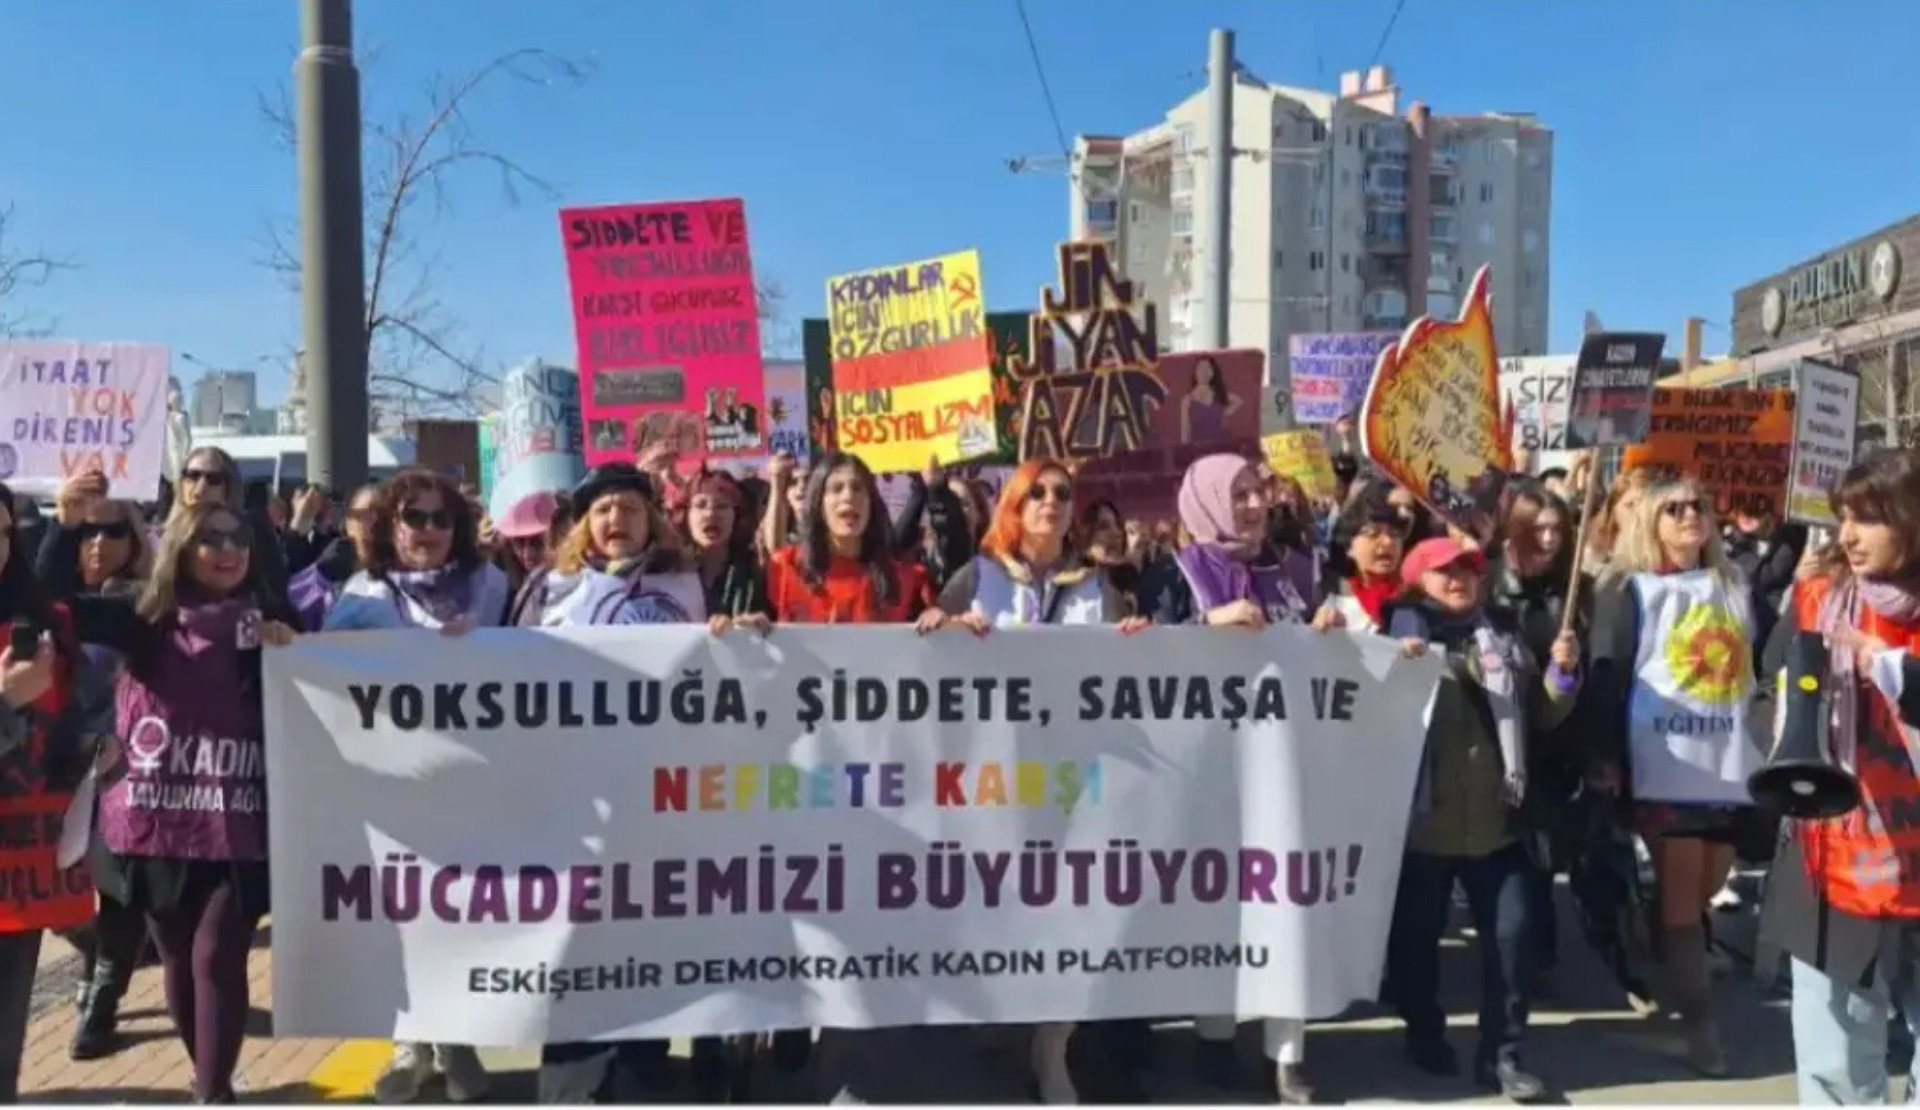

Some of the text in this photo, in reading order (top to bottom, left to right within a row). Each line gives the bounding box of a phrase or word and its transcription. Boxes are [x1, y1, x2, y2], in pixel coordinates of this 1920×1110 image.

[831, 262, 945, 301] KADINLAR
[70, 387, 136, 419] YOK
[59, 450, 129, 479] VAR
[348, 669, 1360, 732] YOKSULLUĞA, ŞİDDETE, SAVAŞA VE
[169, 736, 262, 777] KADIN
[653, 760, 1103, 820] NEFRETE KARŞI
[321, 838, 1364, 924] MÜCADELEMİZİ BÜYÜTÜYORUZ!
[468, 944, 1269, 1000] ESKİŞEHİR DEMOKRATİK KADIN PLATFORMU
